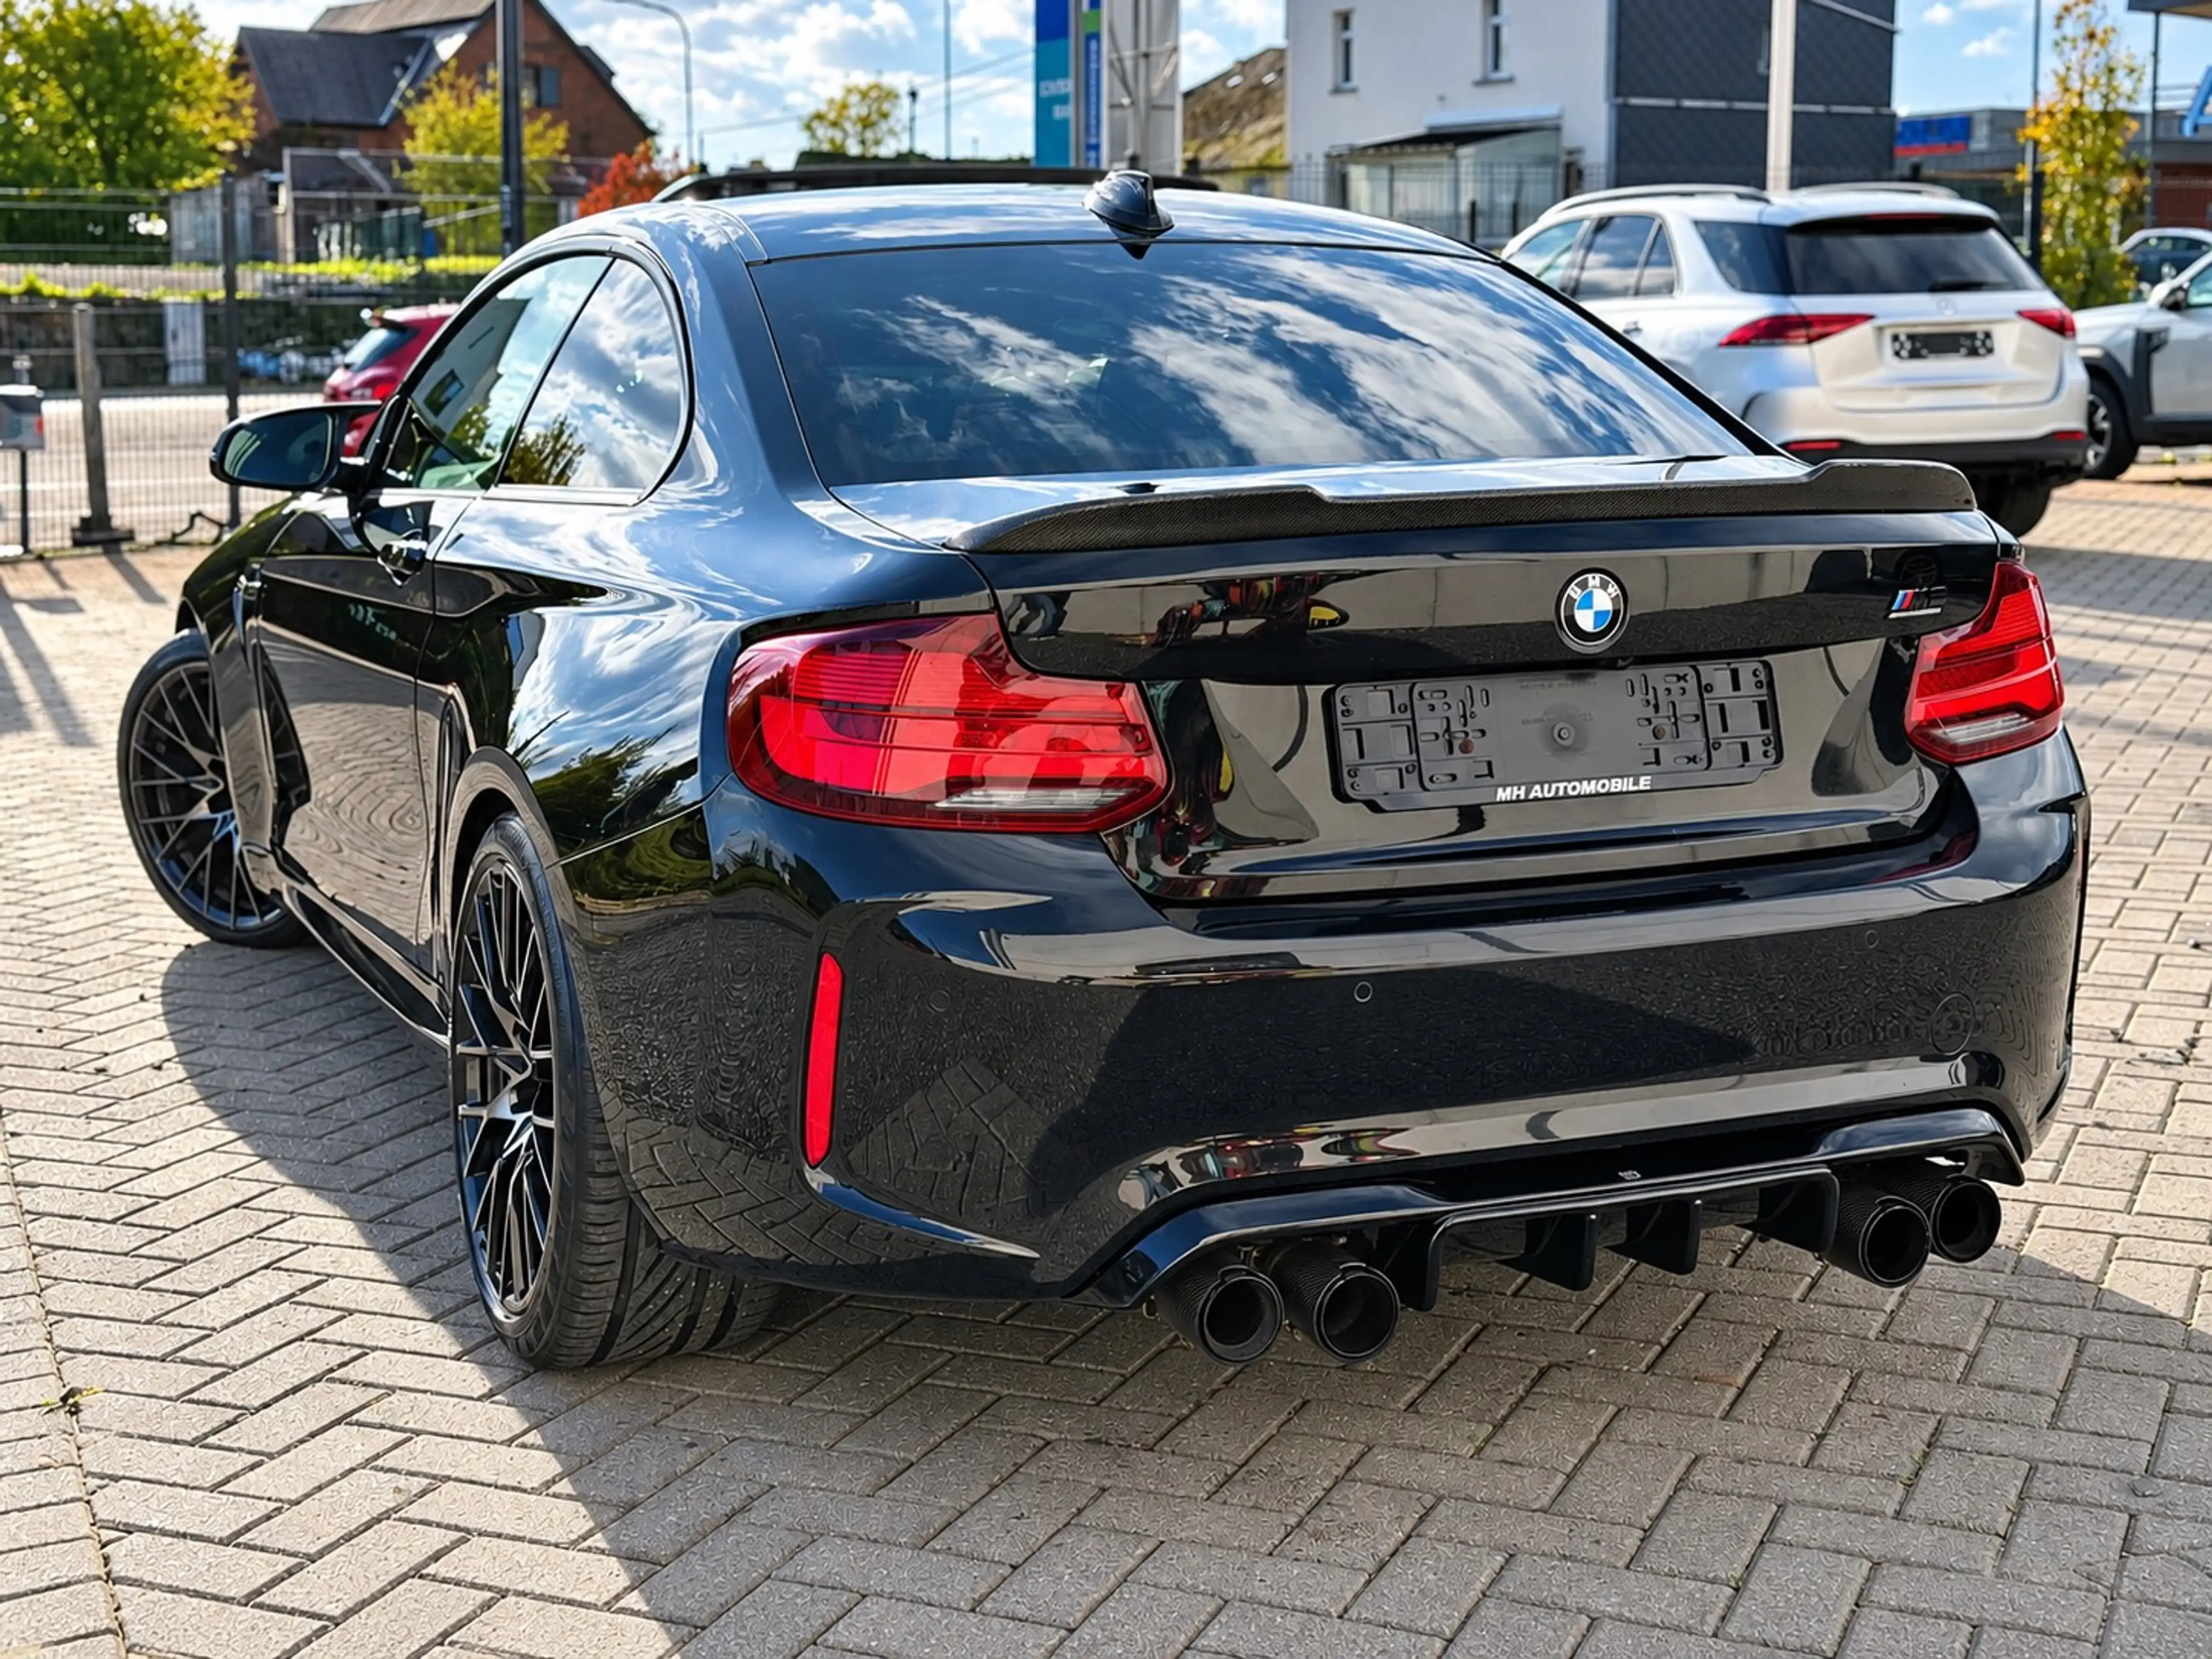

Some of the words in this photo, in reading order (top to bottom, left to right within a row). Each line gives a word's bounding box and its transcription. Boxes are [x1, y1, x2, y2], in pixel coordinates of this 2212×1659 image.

[1569, 574, 1620, 600] BMW
[1496, 785, 1526, 801] MH
[1528, 775, 1652, 800] AUTOMOBILE
